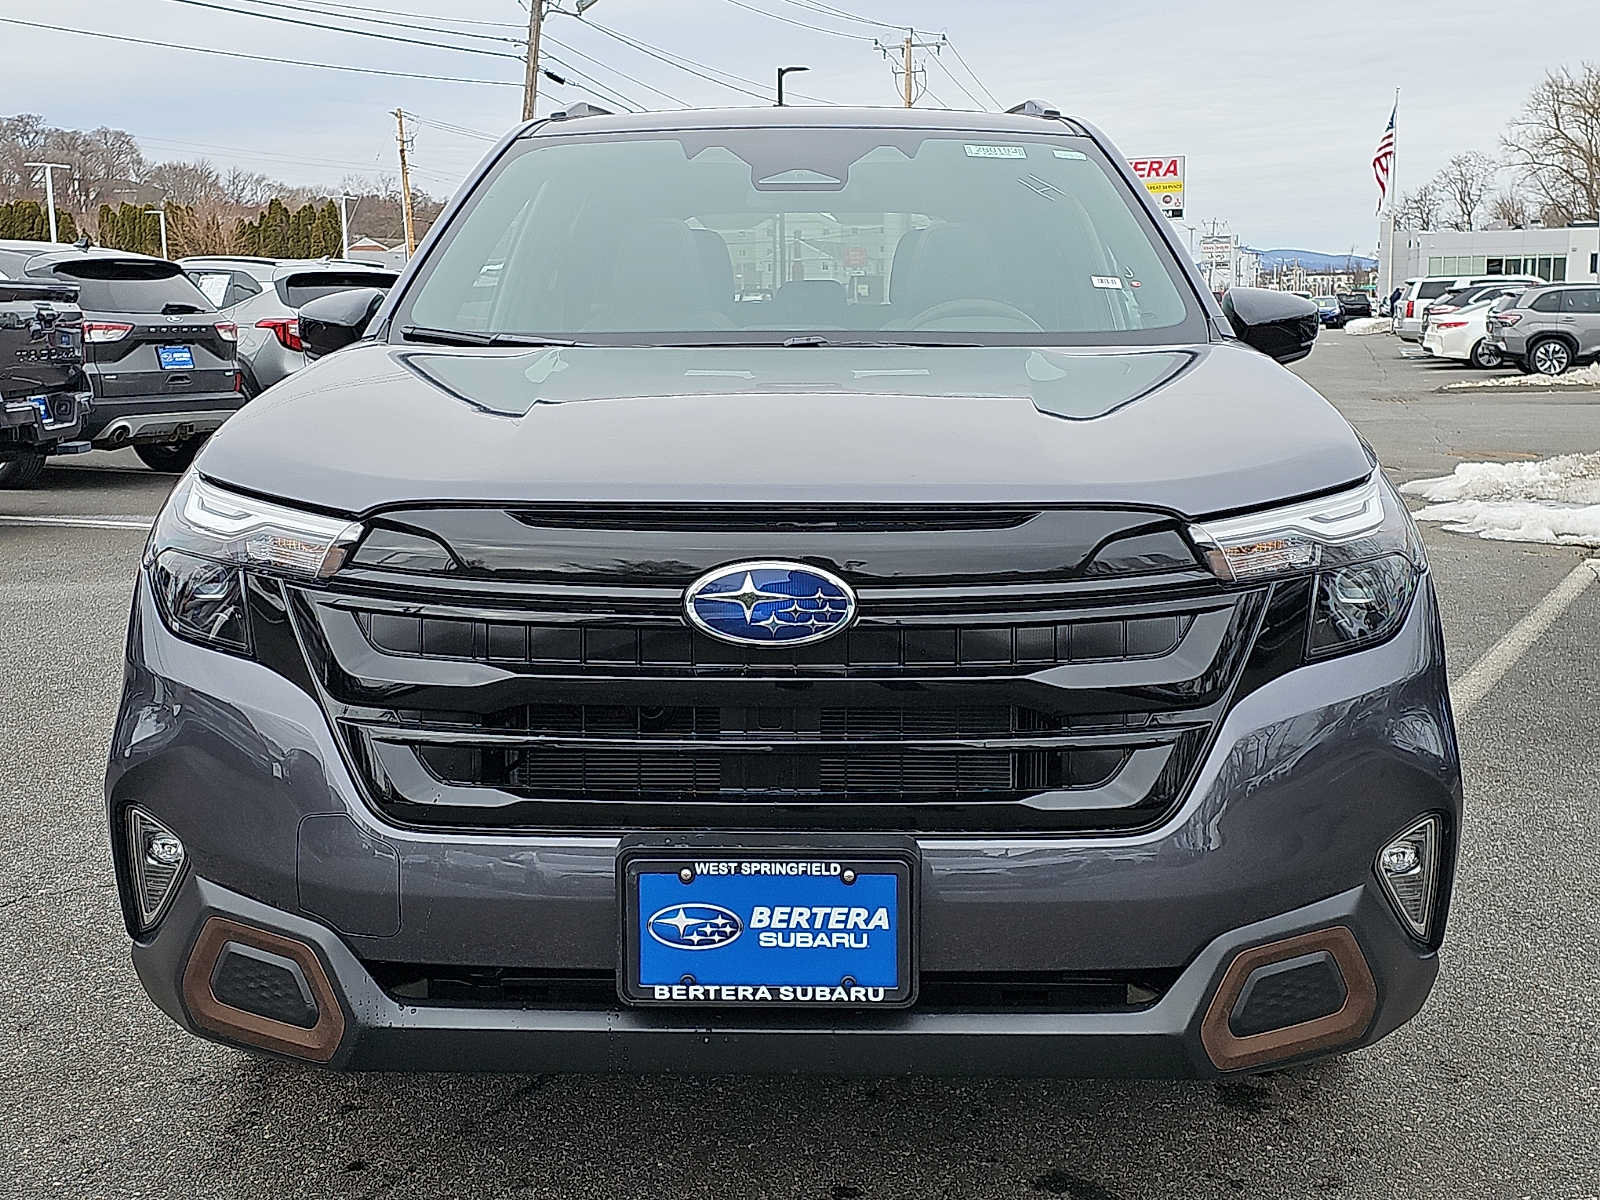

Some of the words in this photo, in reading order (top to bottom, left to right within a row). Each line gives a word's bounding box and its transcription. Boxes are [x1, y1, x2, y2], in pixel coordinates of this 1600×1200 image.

[1129, 160, 1178, 178] ERA
[694, 863, 736, 875] WEST
[741, 862, 841, 875] SPRINGFIELD
[750, 907, 890, 930] BERTERA
[759, 932, 868, 948] SUBARU
[654, 985, 772, 1000] BERTERA
[779, 986, 885, 1001] SUBARU
